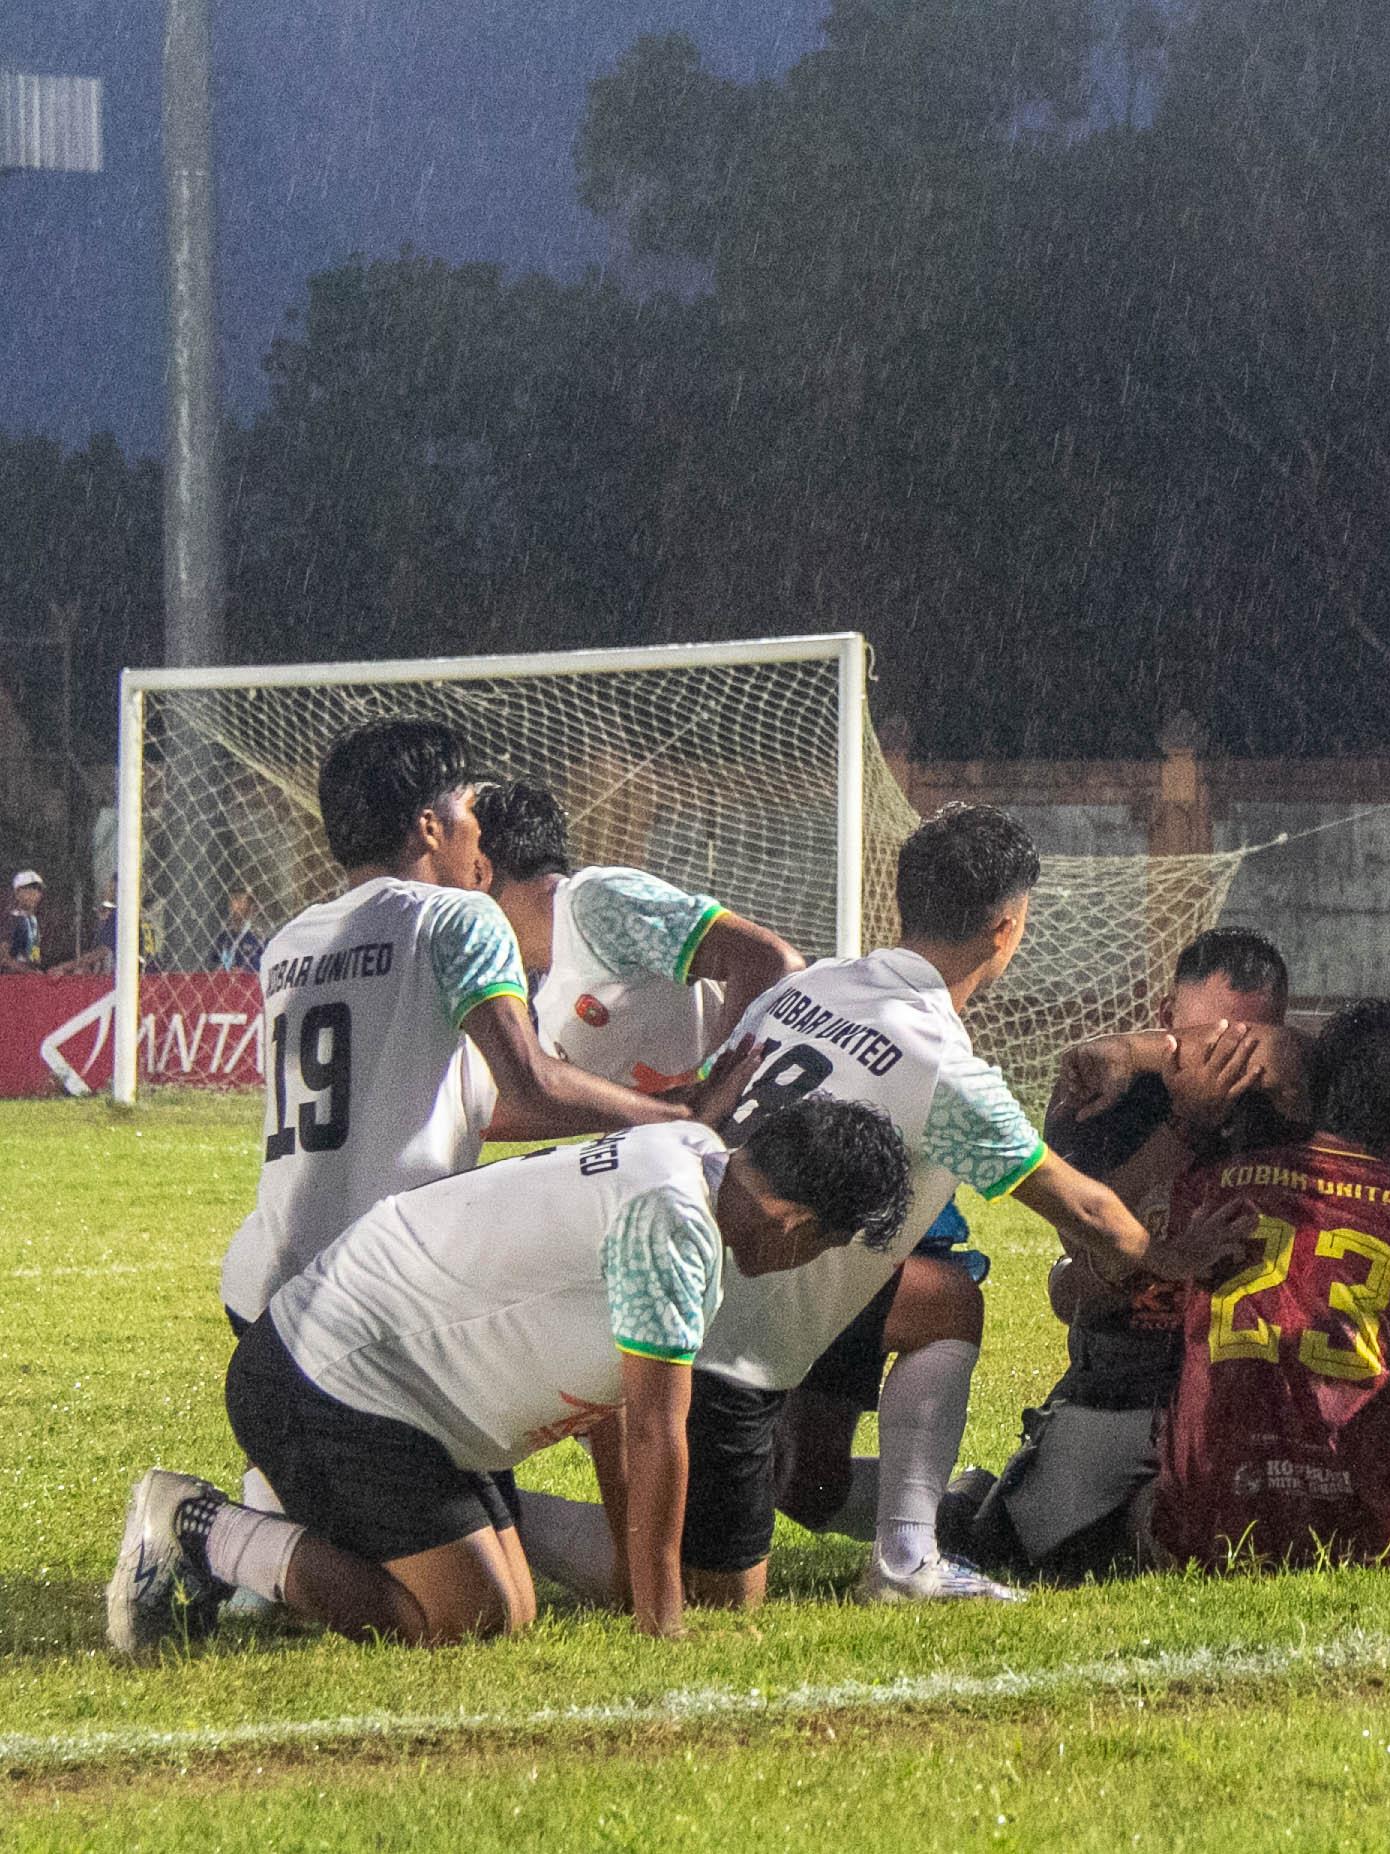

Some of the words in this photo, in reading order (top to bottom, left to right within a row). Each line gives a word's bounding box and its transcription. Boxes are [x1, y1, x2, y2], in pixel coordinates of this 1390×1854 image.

[315, 943, 393, 985] UNITED
[766, 987, 832, 1033] KOBAR
[815, 1018, 903, 1077] UNITED
[265, 1002, 351, 1163] 19
